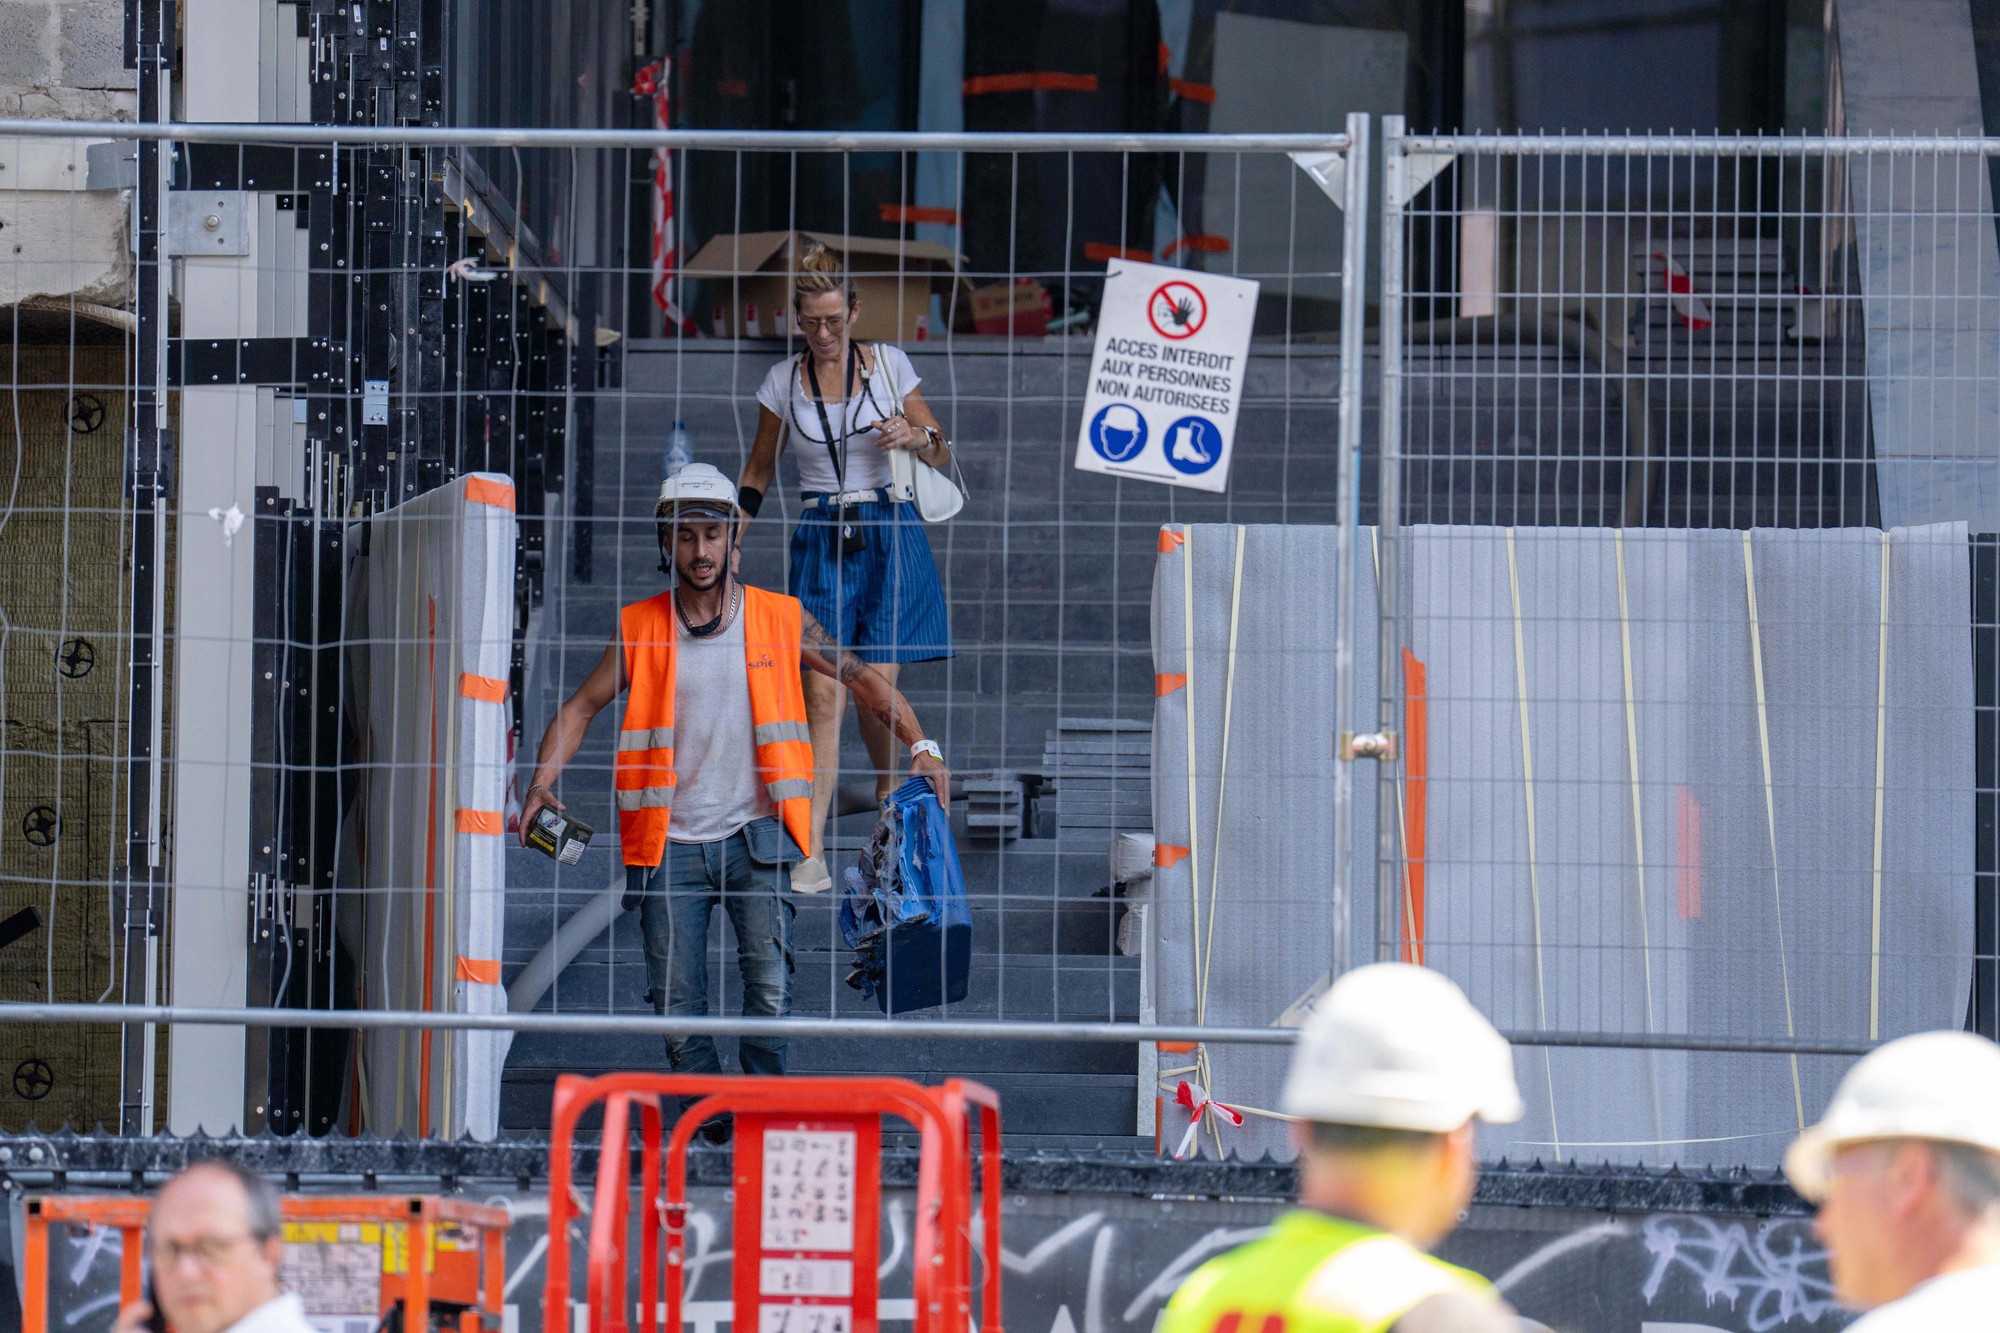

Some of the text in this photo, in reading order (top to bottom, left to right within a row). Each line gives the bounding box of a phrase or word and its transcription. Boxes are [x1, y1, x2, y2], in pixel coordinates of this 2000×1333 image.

[1106, 337, 1234, 371] ACCES INTERDIT
[1101, 358, 1231, 393] AUX PERSONNES
[1095, 379, 1230, 415] NON AUTORISEES
